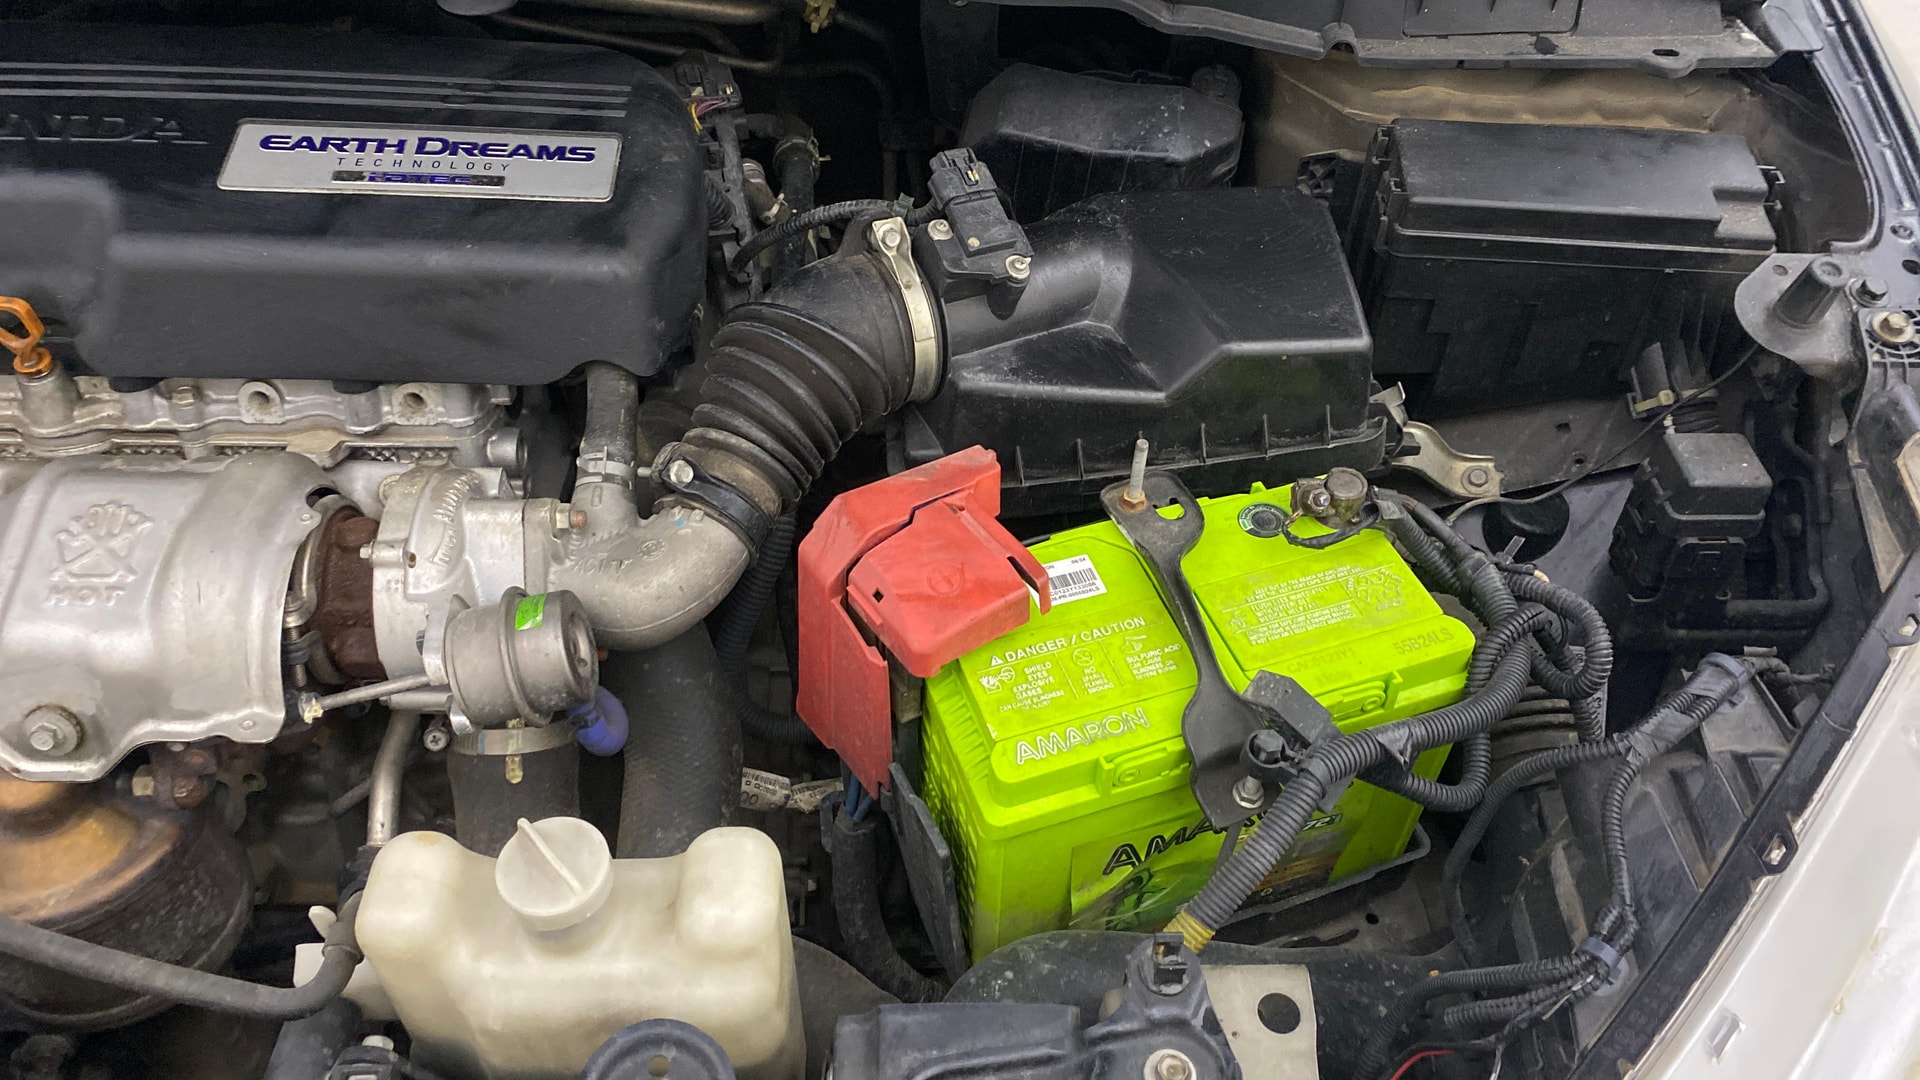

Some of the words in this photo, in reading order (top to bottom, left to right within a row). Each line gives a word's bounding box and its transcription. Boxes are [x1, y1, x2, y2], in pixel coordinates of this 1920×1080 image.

[258, 134, 407, 155] EARTH
[413, 136, 596, 163] DREAMS
[337, 157, 510, 172] TECHNOLOGY
[1005, 637, 1067, 662] DANGER
[1071, 634, 1077, 645] /
[1080, 616, 1146, 641] CAUTION
[1024, 661, 1052, 674] SHIELD
[1084, 666, 1096, 675] NO
[1027, 669, 1048, 682] EYES
[1012, 675, 1055, 694] EXPLOSIVE
[1016, 687, 1043, 700] GASES
[1016, 707, 1151, 765] AMARON
